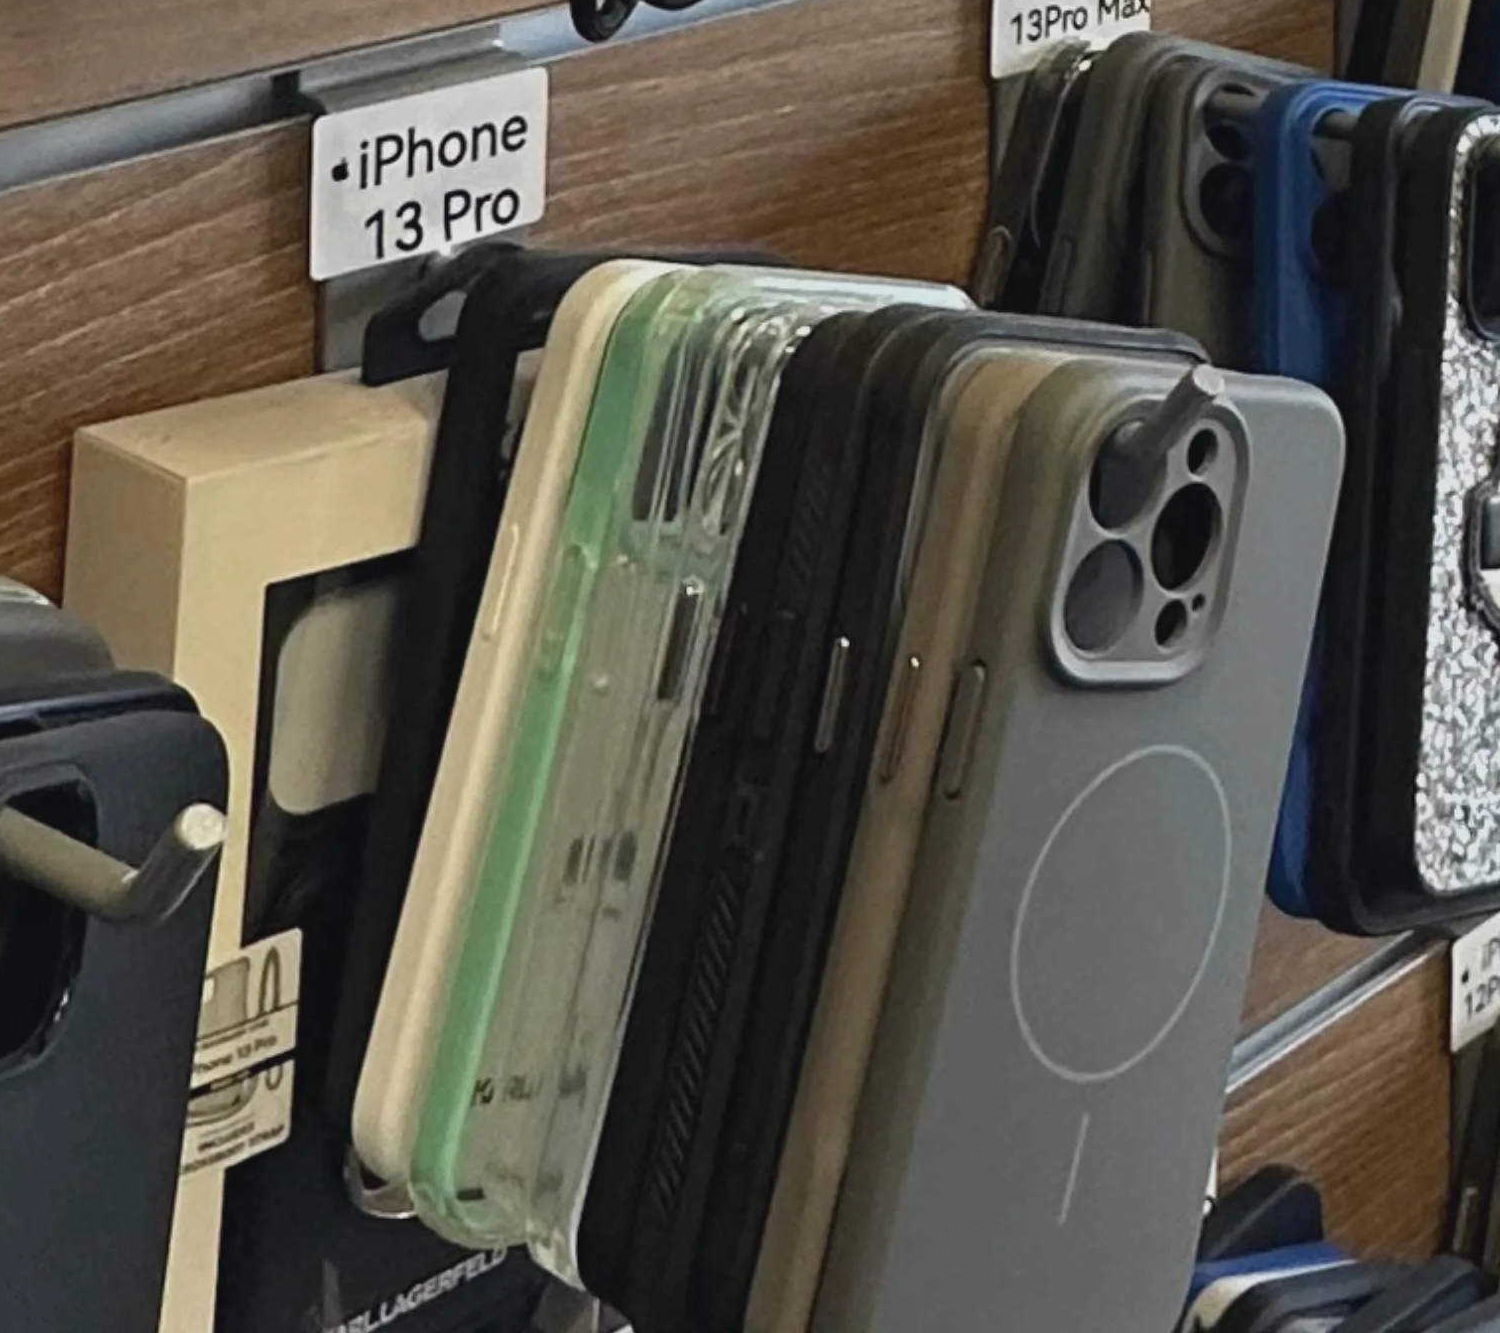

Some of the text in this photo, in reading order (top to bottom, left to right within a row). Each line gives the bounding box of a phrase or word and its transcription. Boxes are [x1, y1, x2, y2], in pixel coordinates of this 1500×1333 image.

[1010, 0, 1089, 47] 13Pro
[358, 112, 529, 191] iPhone
[363, 186, 520, 261] 13 Pro
[379, 1247, 509, 1324] LAGERFELD
